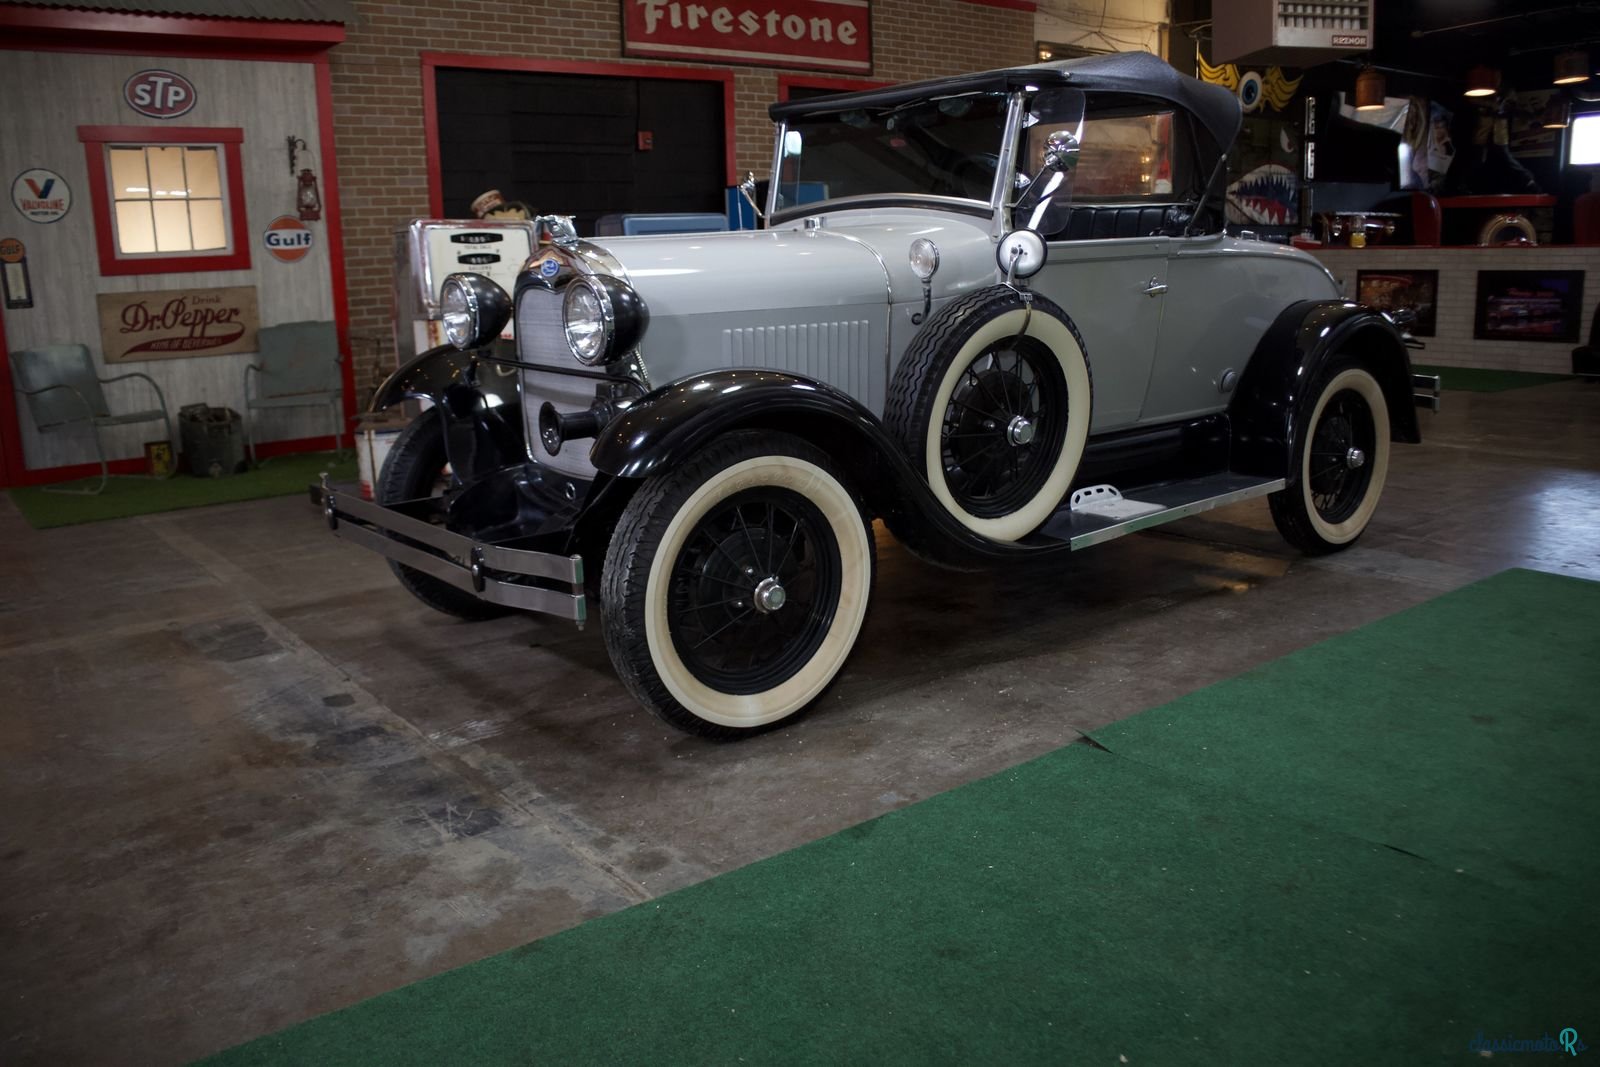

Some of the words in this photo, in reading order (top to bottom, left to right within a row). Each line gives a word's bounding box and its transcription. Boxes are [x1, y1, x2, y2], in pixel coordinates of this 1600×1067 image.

[636, 0, 858, 45] Firestone
[134, 76, 186, 109] STP
[20, 198, 65, 212] VALVOLINE
[266, 232, 311, 247] Gulf
[192, 295, 222, 305] Drink
[161, 296, 240, 338] Pepper
